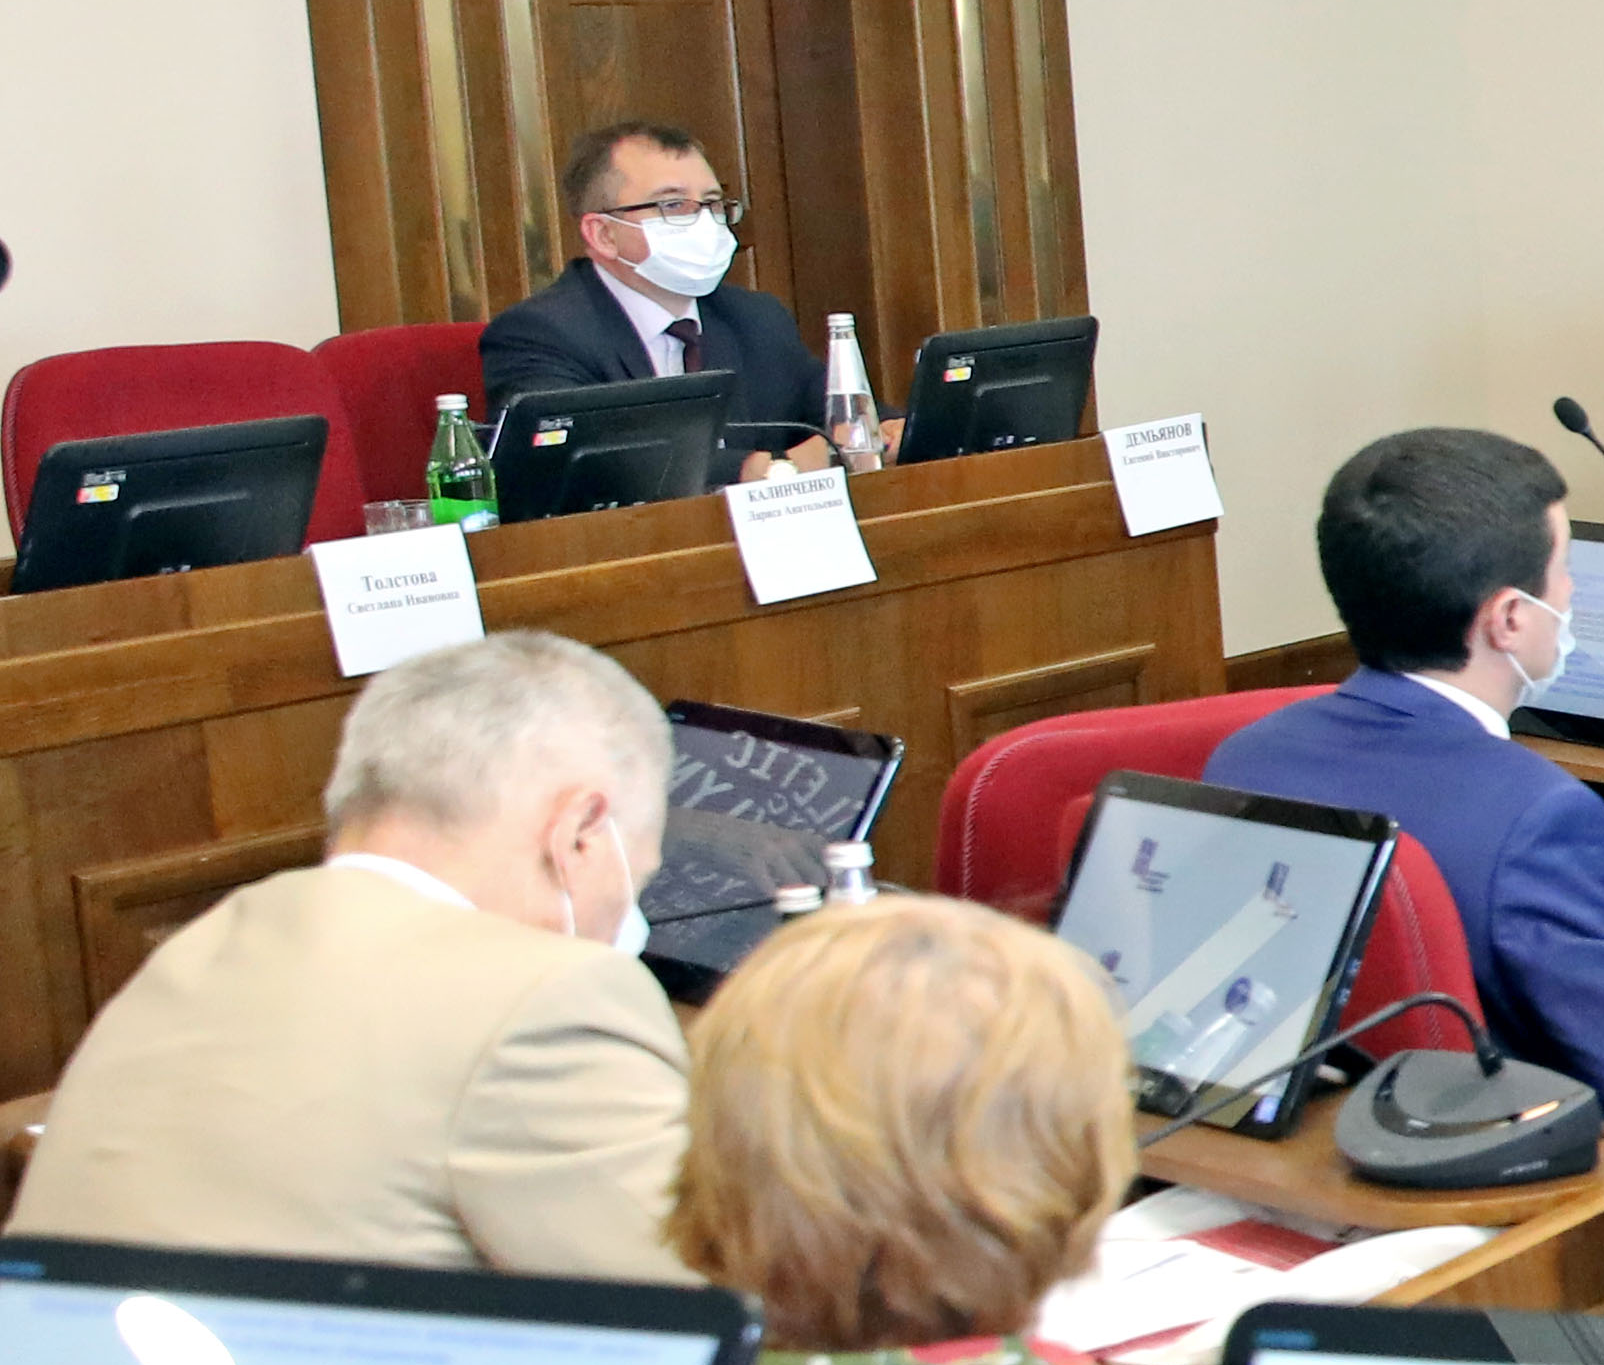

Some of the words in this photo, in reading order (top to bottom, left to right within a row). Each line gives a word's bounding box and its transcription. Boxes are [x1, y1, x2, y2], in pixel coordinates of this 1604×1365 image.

[1125, 422, 1193, 449] ДЕМЬЯНОВ
[747, 476, 836, 503] КАЛИНЧЕНКО
[361, 570, 439, 593] Толстова
[347, 599, 403, 615] Светлана
[404, 589, 461, 607] Ивановна
